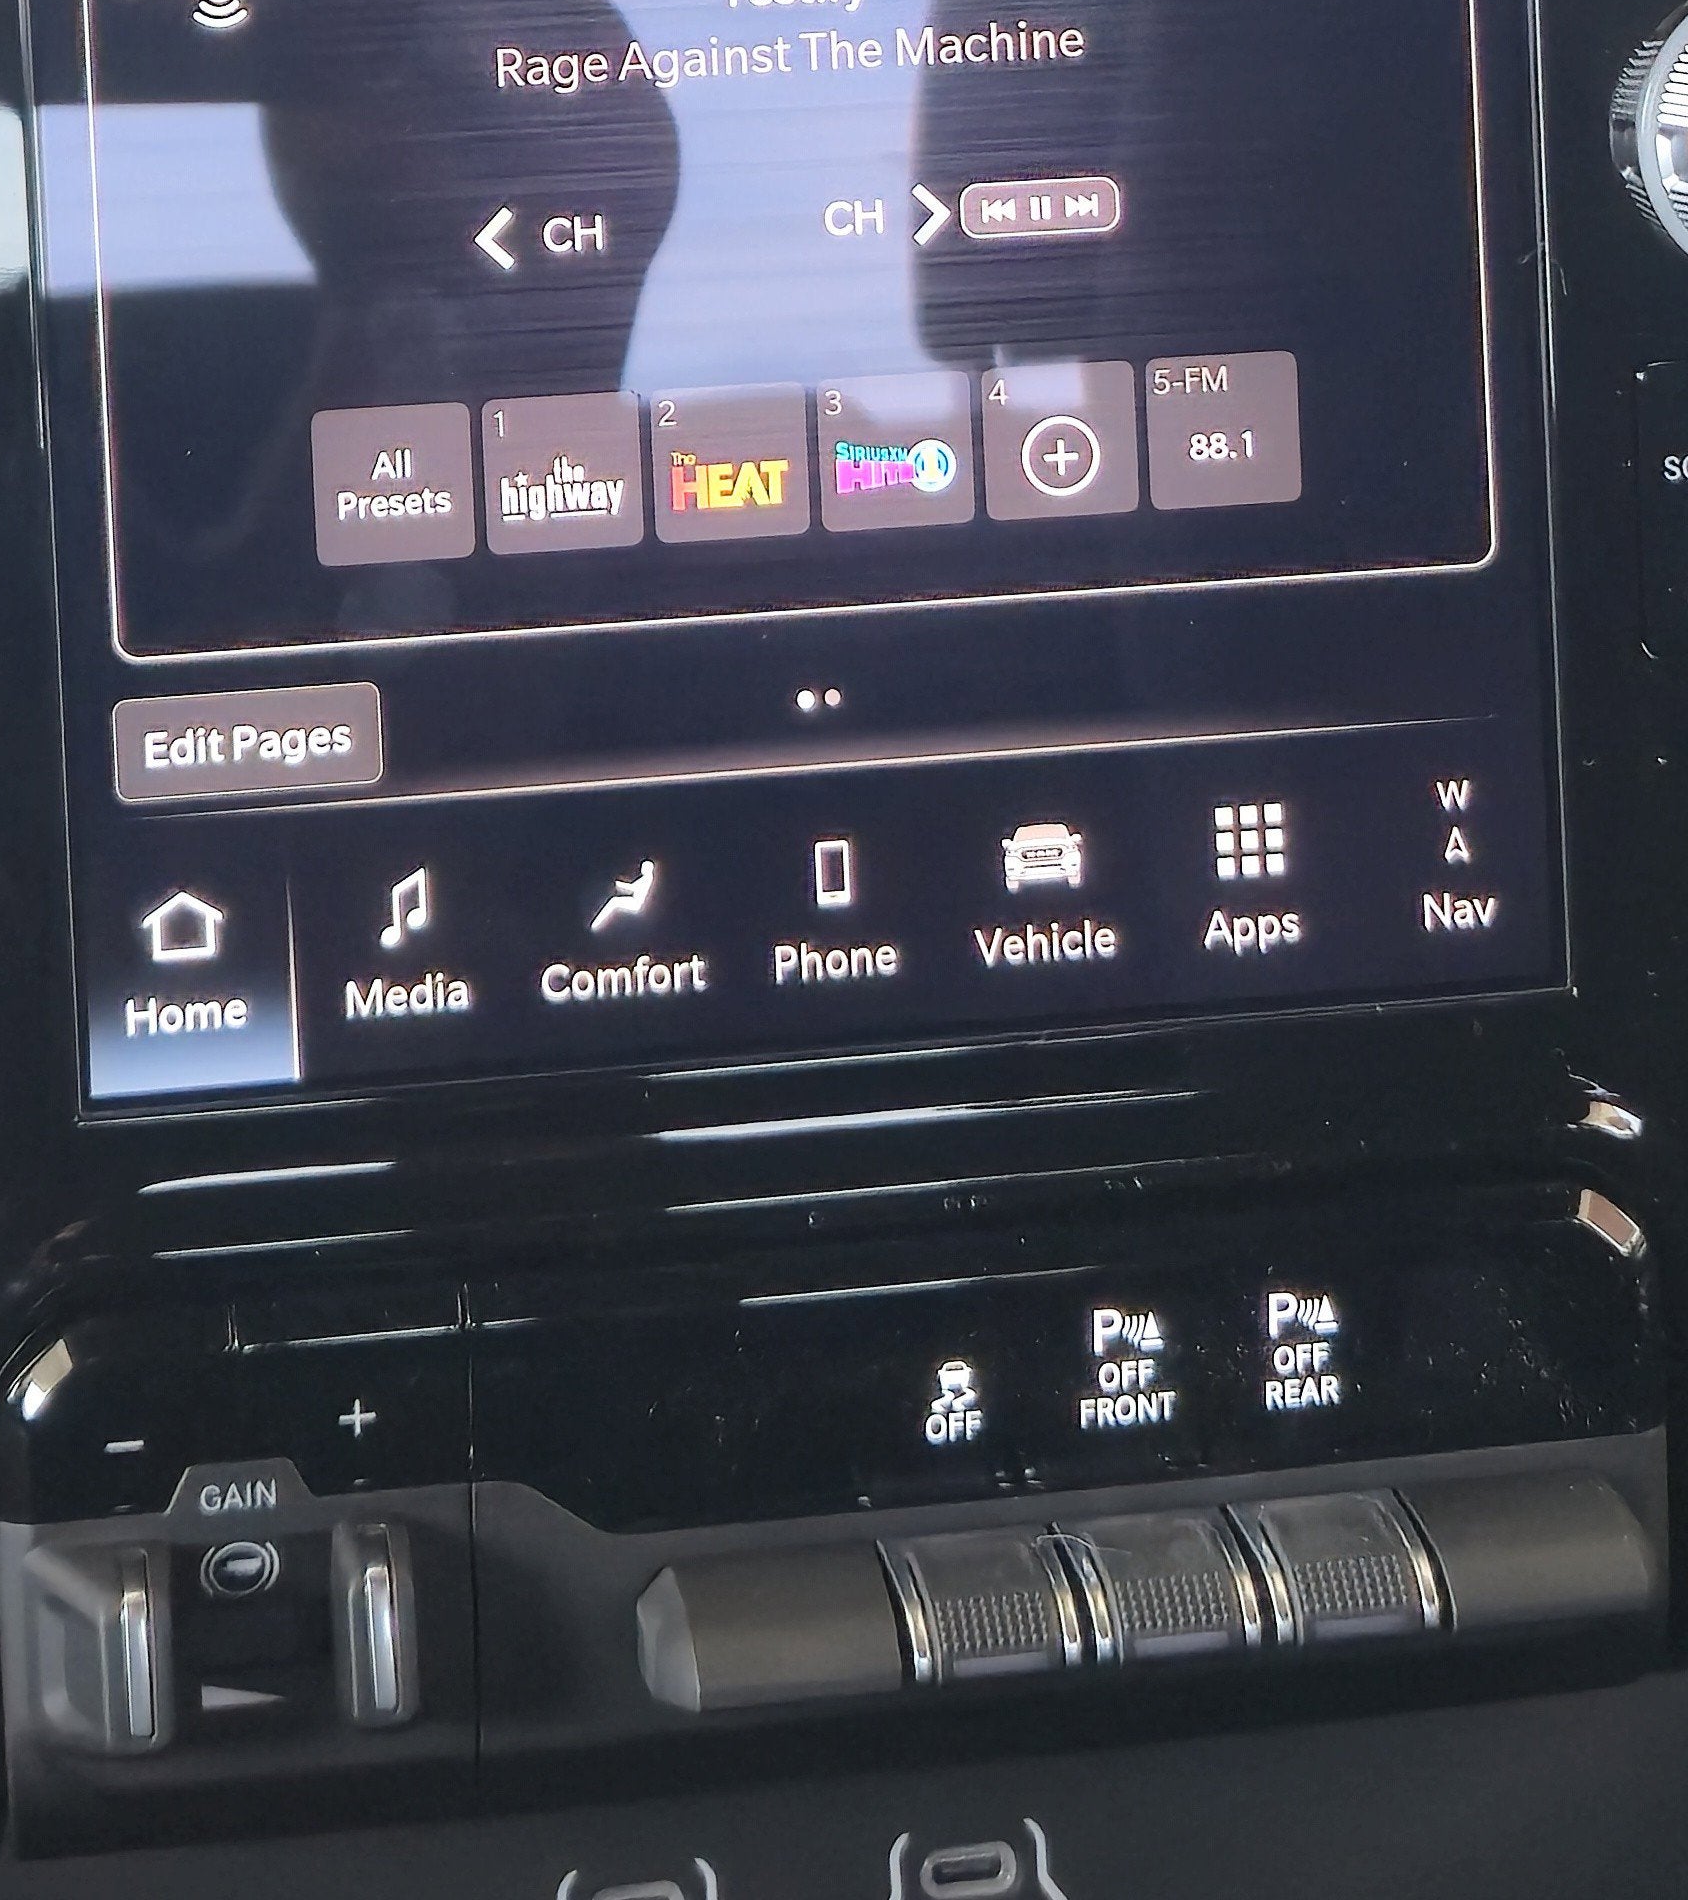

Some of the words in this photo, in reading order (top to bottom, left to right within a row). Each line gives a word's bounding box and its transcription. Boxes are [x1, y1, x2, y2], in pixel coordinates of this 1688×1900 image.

[496, 45, 609, 93] Rage
[619, 35, 792, 88] Against
[799, 28, 883, 71] The
[896, 20, 1085, 67] Machine
[542, 214, 605, 254] CH
[824, 199, 884, 236] CH
[988, 379, 1009, 406] 4
[1153, 365, 1228, 395] 5-FM
[657, 400, 677, 427] 2
[824, 390, 843, 416] 3
[494, 410, 506, 438] 1
[1188, 430, 1254, 461] 88.1
[372, 448, 412, 481] All
[500, 474, 625, 521] highway
[672, 459, 789, 511] HEAT
[337, 487, 452, 521] Presets
[143, 725, 225, 769] Edit
[233, 721, 352, 769] Pages
[1435, 779, 1471, 810] W
[1423, 892, 1496, 933] Nav
[974, 920, 1117, 969] Vehicle
[1203, 909, 1301, 955] Apps
[541, 954, 707, 1004] Comfort
[774, 942, 898, 985] Phone
[345, 972, 470, 1020] Media
[126, 994, 248, 1038] Home
[1272, 1341, 1330, 1374] OFF
[1097, 1359, 1155, 1393] OFF
[1265, 1376, 1340, 1410] REAR
[925, 1410, 983, 1444] OFF
[1080, 1391, 1175, 1429] FRONT
[200, 1479, 276, 1512] GAIN
